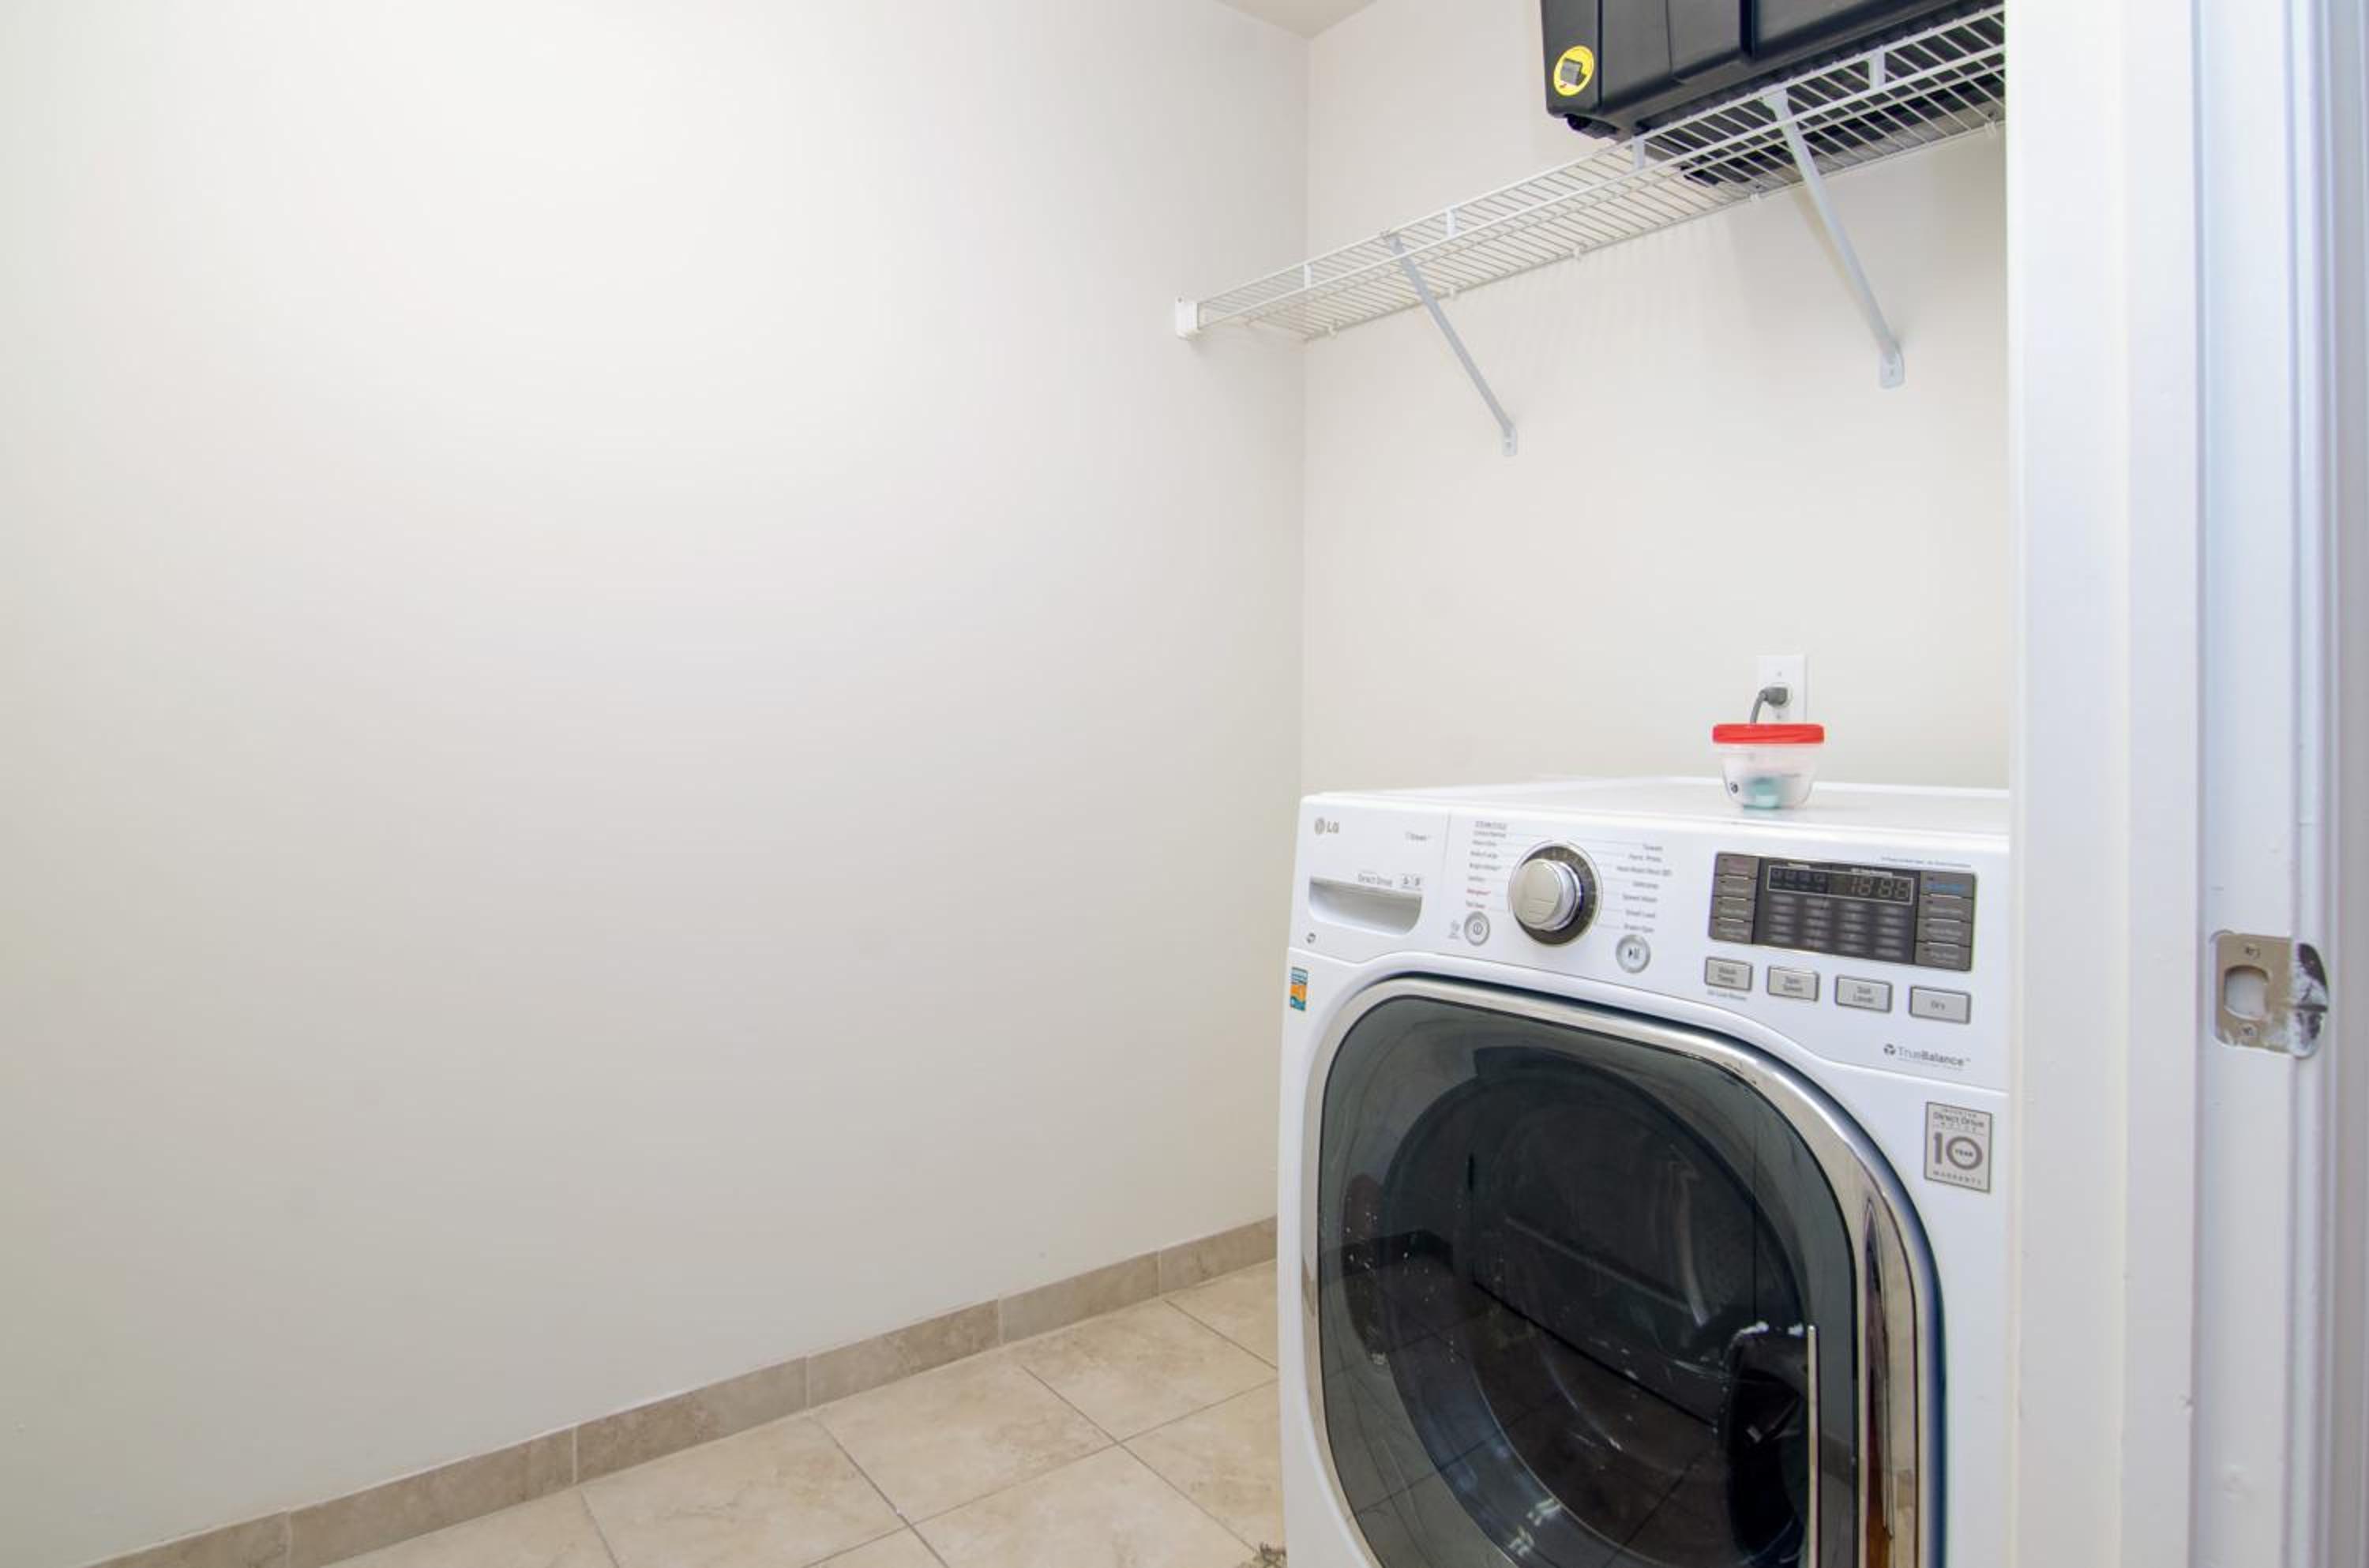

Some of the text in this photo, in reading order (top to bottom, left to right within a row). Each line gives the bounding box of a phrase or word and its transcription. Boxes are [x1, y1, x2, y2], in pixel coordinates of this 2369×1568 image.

[1933, 1112, 1984, 1127] Direct Drive
[1934, 1132, 1983, 1170] 10
